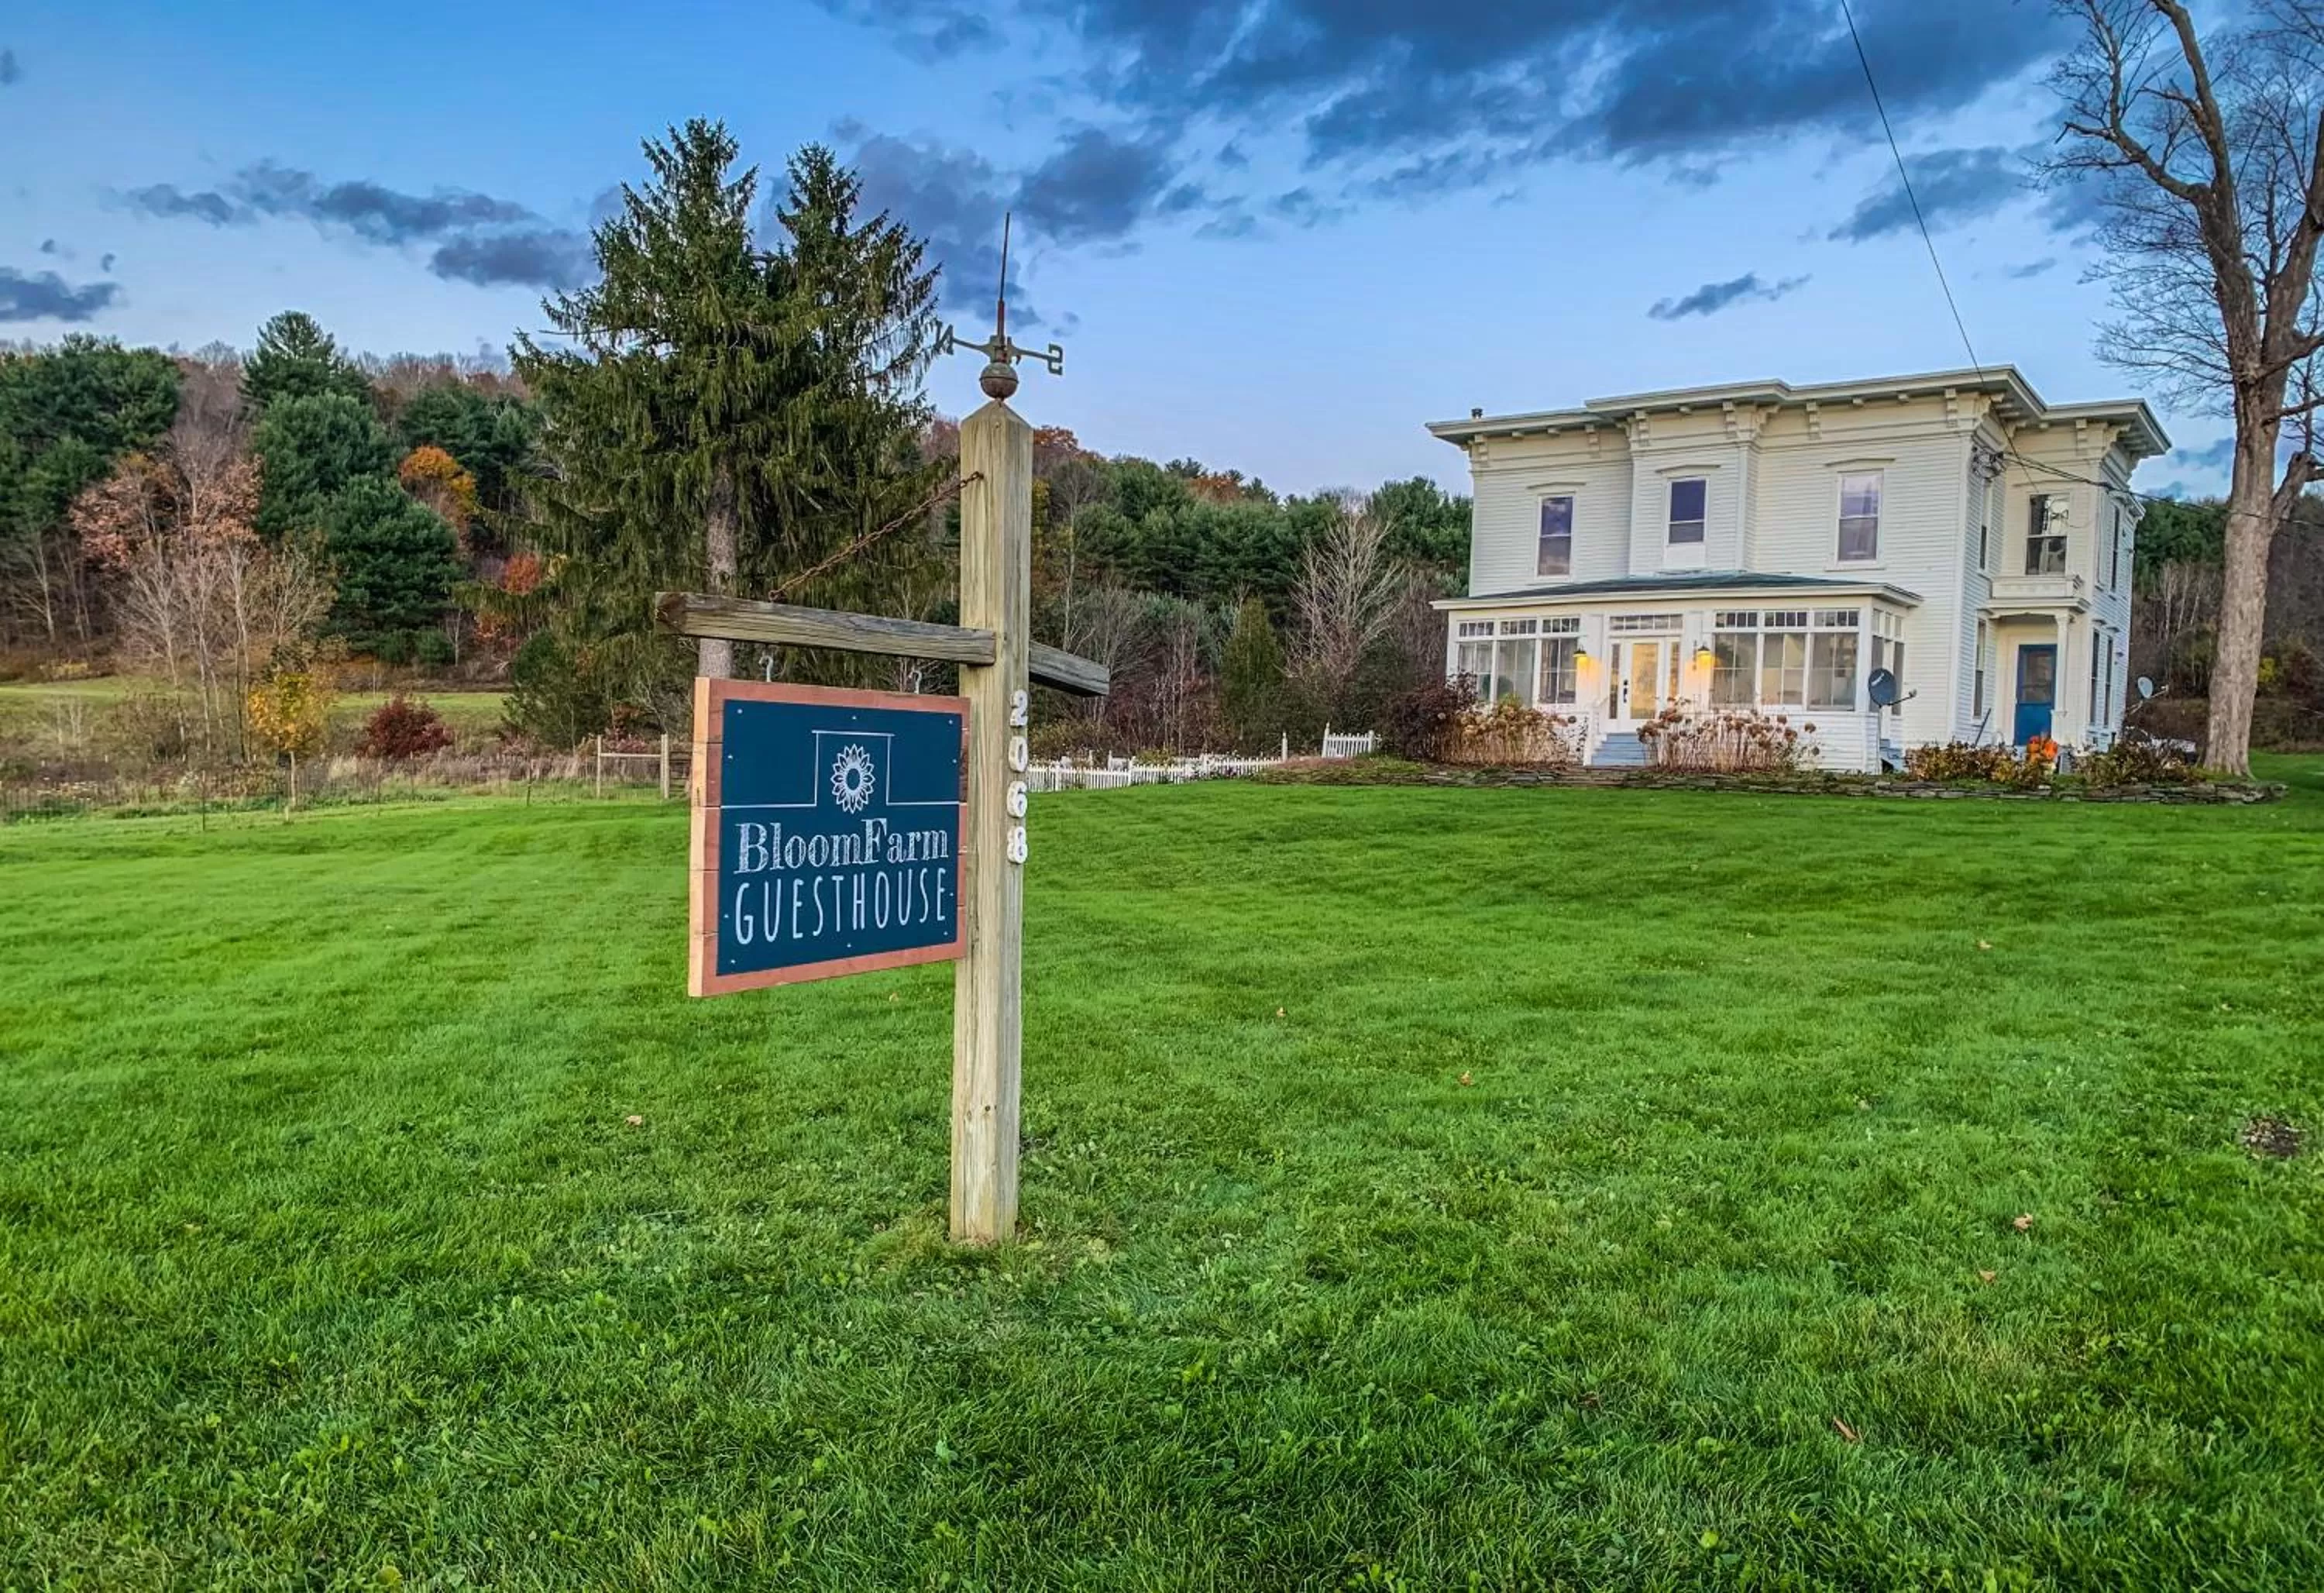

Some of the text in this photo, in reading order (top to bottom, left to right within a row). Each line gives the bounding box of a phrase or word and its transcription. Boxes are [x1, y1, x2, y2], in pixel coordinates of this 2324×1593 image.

[1007, 690, 1028, 864] 2068
[734, 817, 949, 874] BloomFarm
[736, 867, 946, 944] GUESTHOUSE
